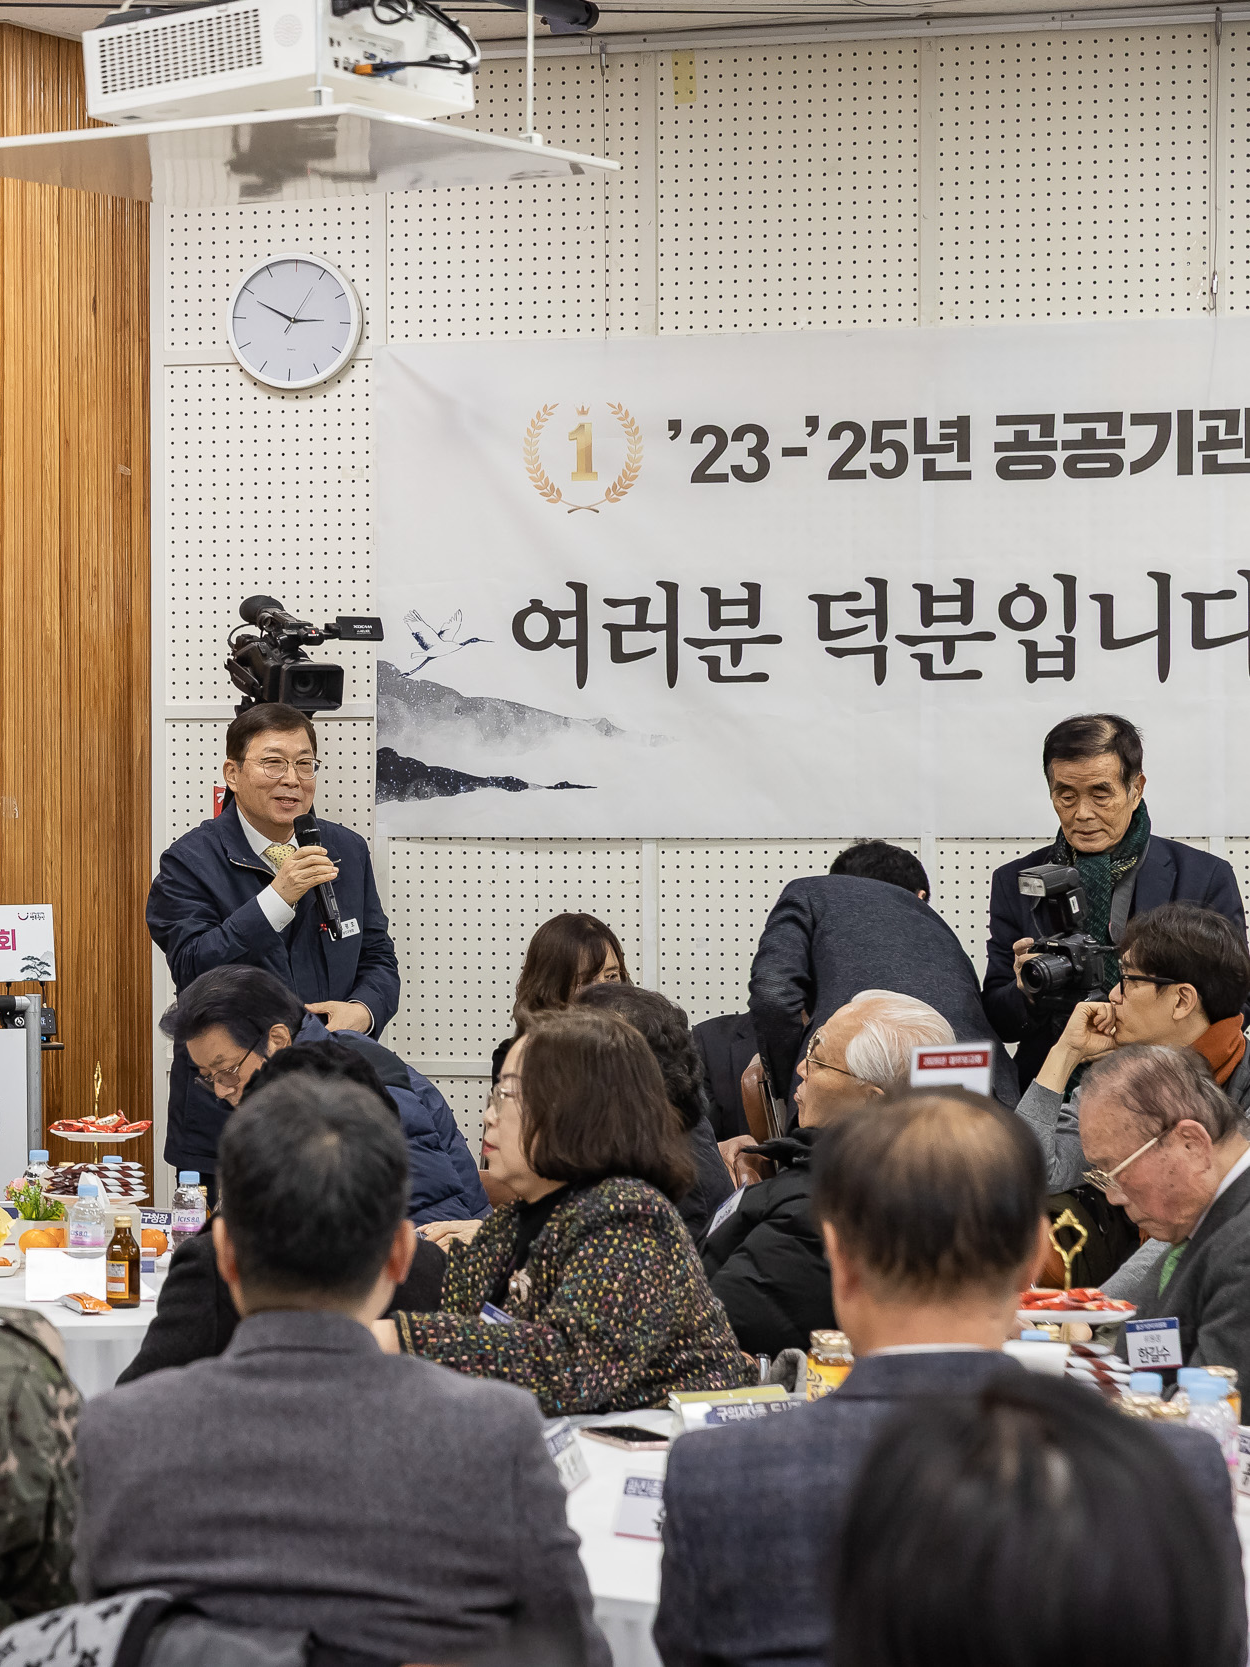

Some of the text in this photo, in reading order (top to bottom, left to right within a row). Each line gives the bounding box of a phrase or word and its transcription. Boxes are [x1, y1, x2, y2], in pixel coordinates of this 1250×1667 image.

[993, 408, 1250, 481] 공공기관
[511, 569, 1250, 690] 여러분 덕분입니다
[142, 1212, 169, 1224] 구청장
